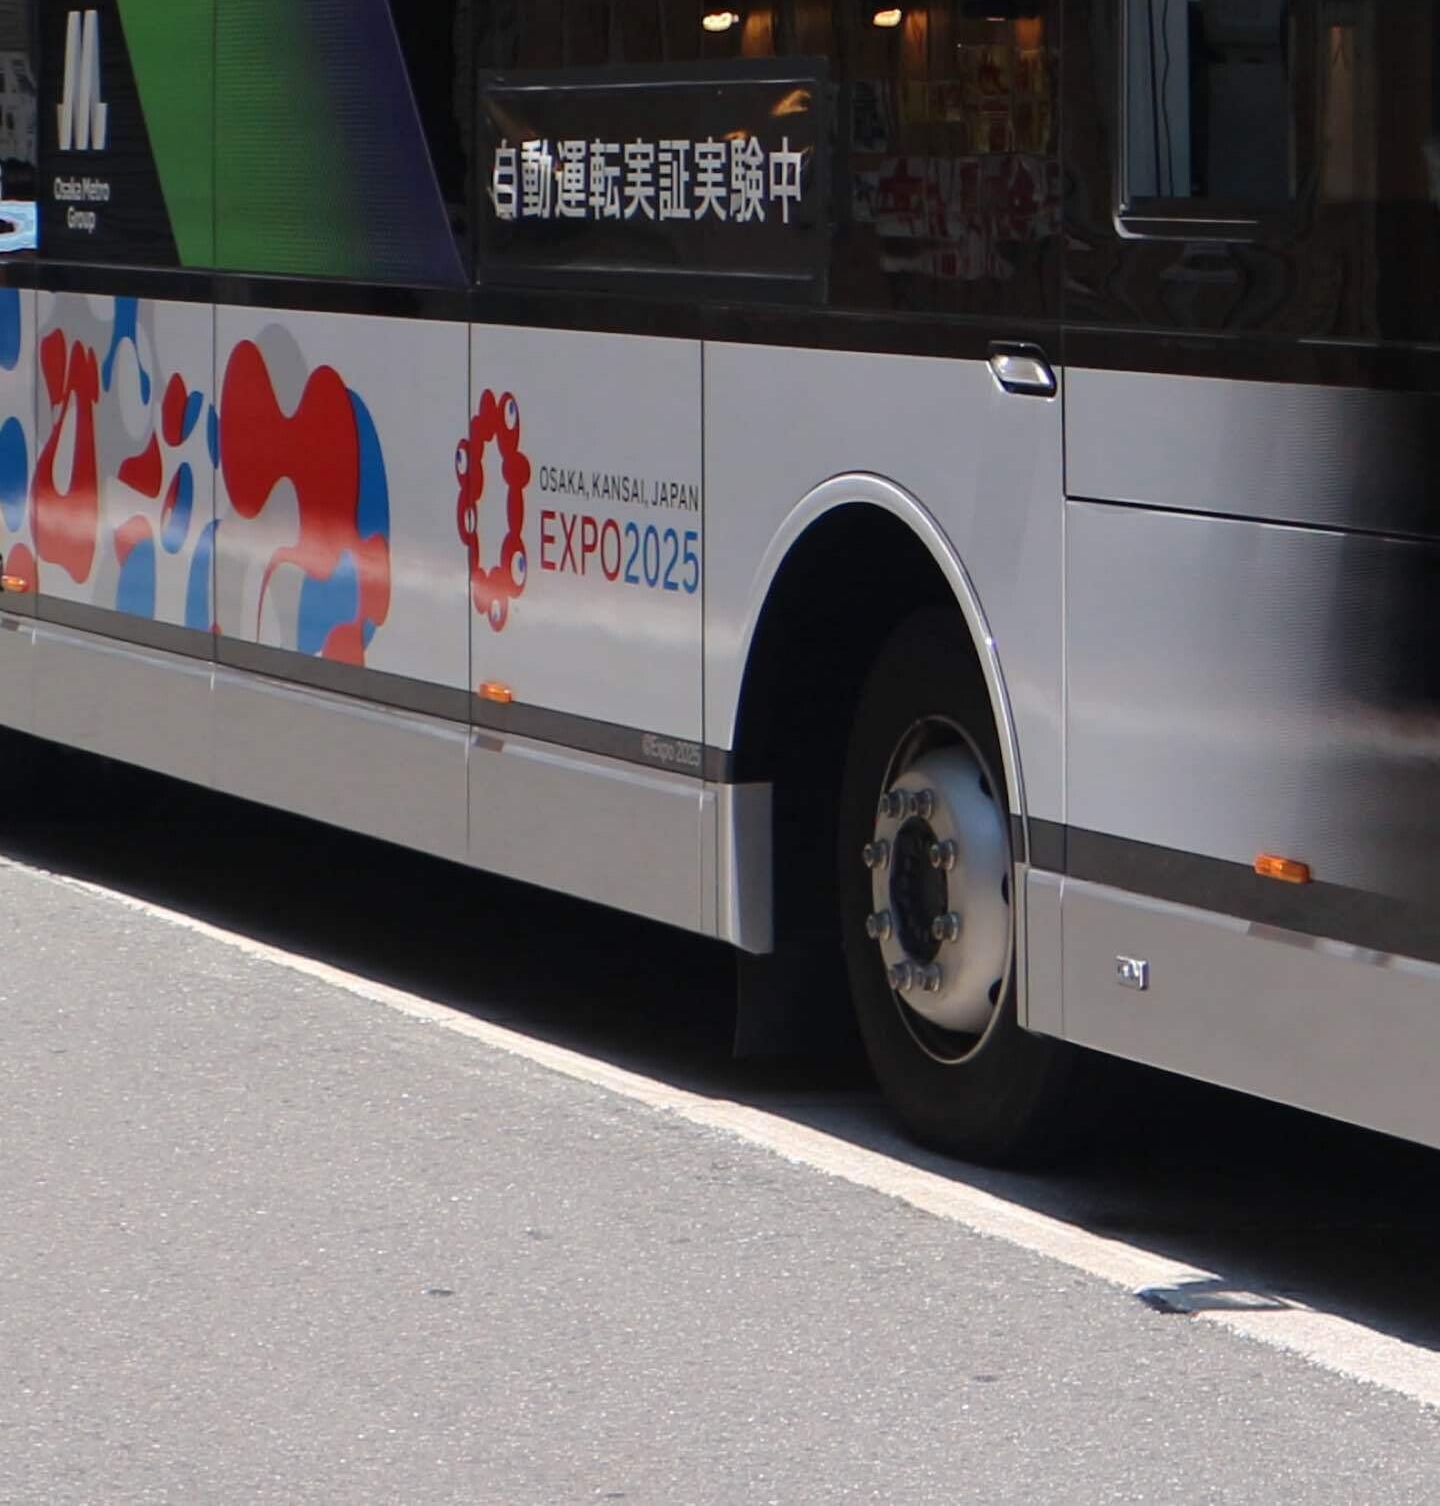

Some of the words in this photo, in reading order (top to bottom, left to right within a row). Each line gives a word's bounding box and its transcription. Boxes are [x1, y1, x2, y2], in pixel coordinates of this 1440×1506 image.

[488, 136, 802, 224] 自動運転実証実験中
[67, 206, 96, 235] Group
[540, 465, 590, 500] OSAKA,
[592, 473, 649, 508] KANSAI,
[651, 480, 699, 512] JAPAN
